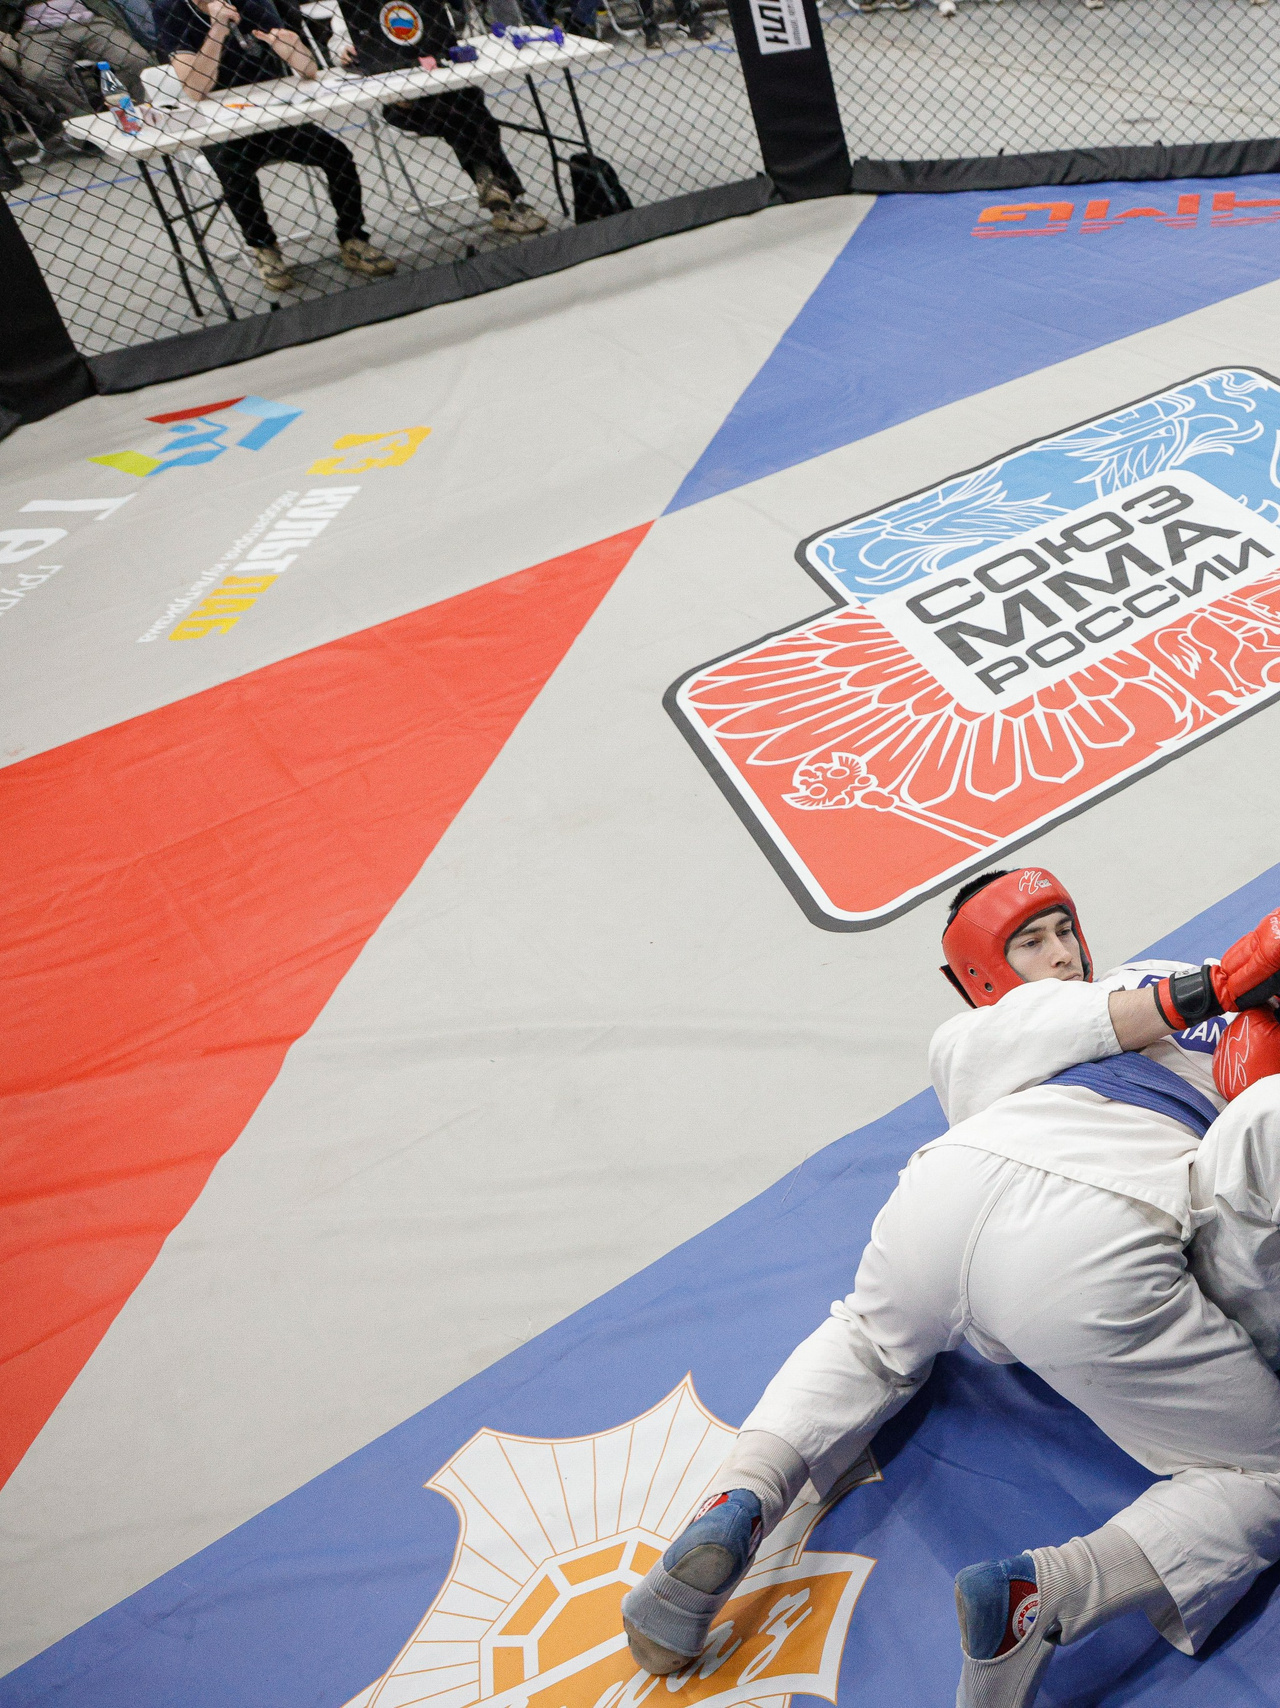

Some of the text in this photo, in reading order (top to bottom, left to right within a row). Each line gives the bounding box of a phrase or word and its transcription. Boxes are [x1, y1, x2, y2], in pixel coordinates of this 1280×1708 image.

[905, 485, 1194, 624] СОЮЗ
[933, 519, 1242, 666] ММА
[974, 537, 1275, 695] РОССИИ
